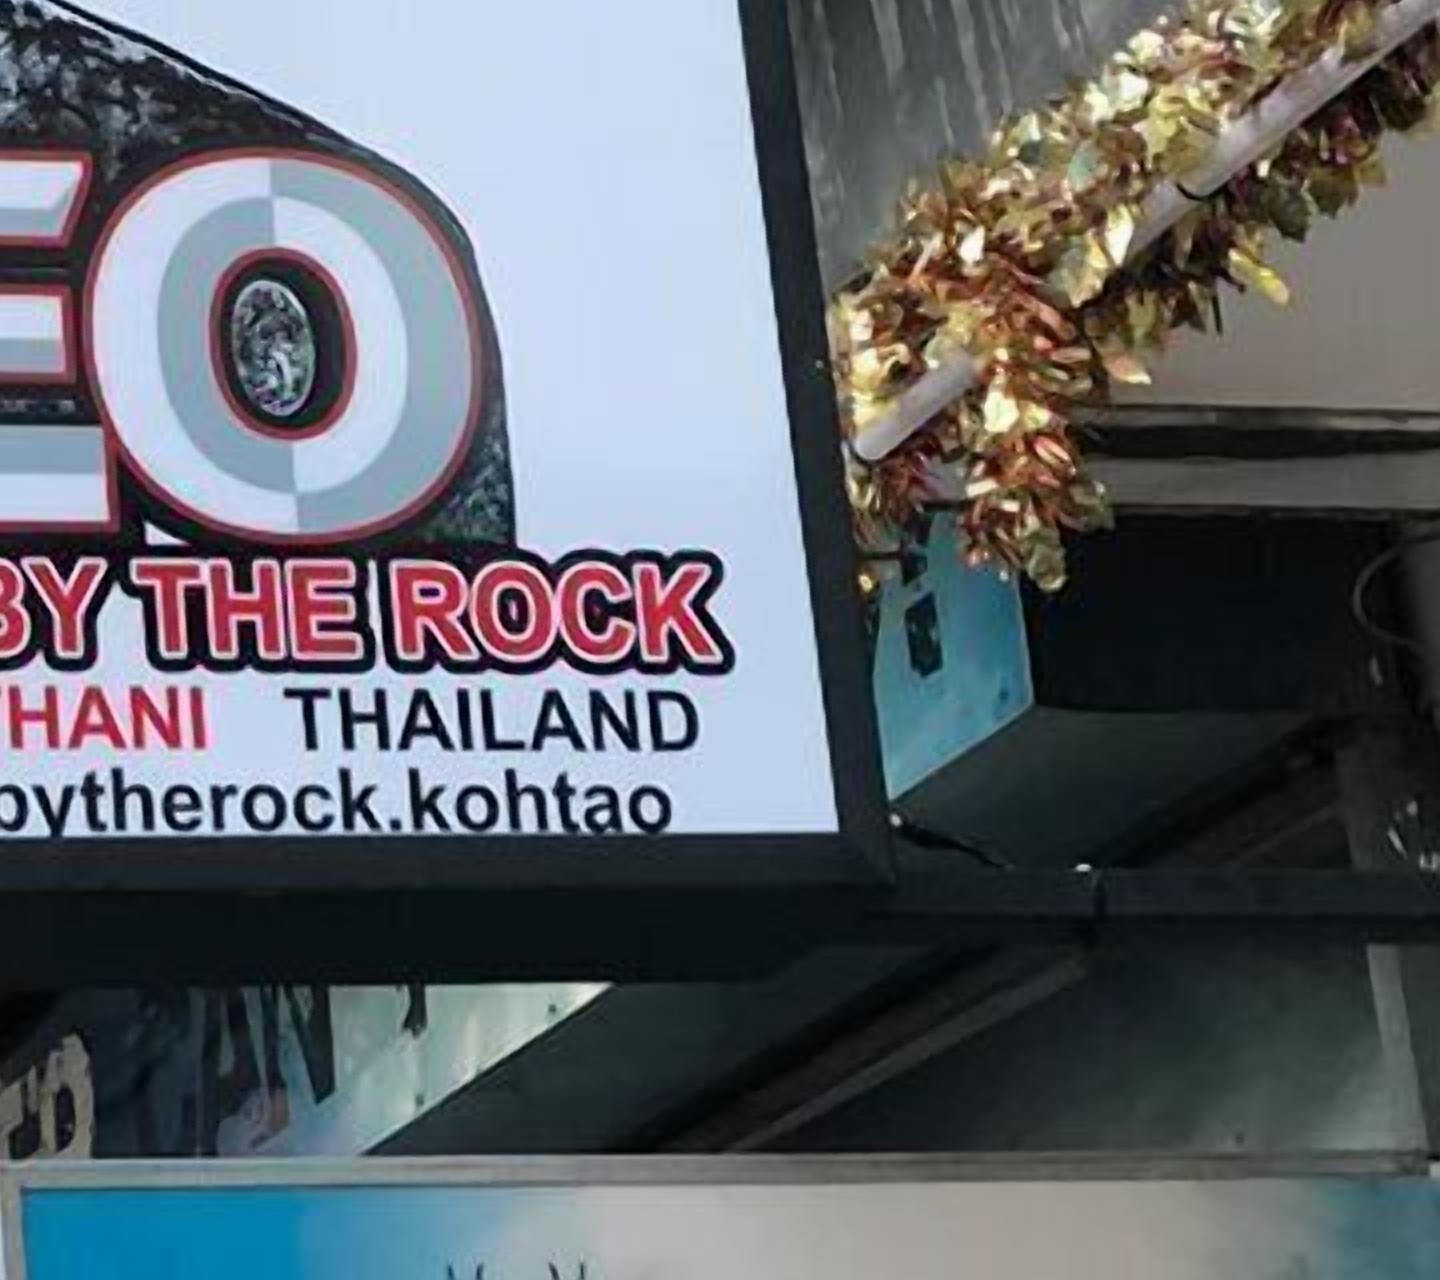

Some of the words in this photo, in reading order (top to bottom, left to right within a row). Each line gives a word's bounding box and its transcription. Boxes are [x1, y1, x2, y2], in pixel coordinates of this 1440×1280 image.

[124, 552, 370, 670] THE
[382, 550, 734, 674] ROCK
[284, 686, 701, 753] THAILAND
